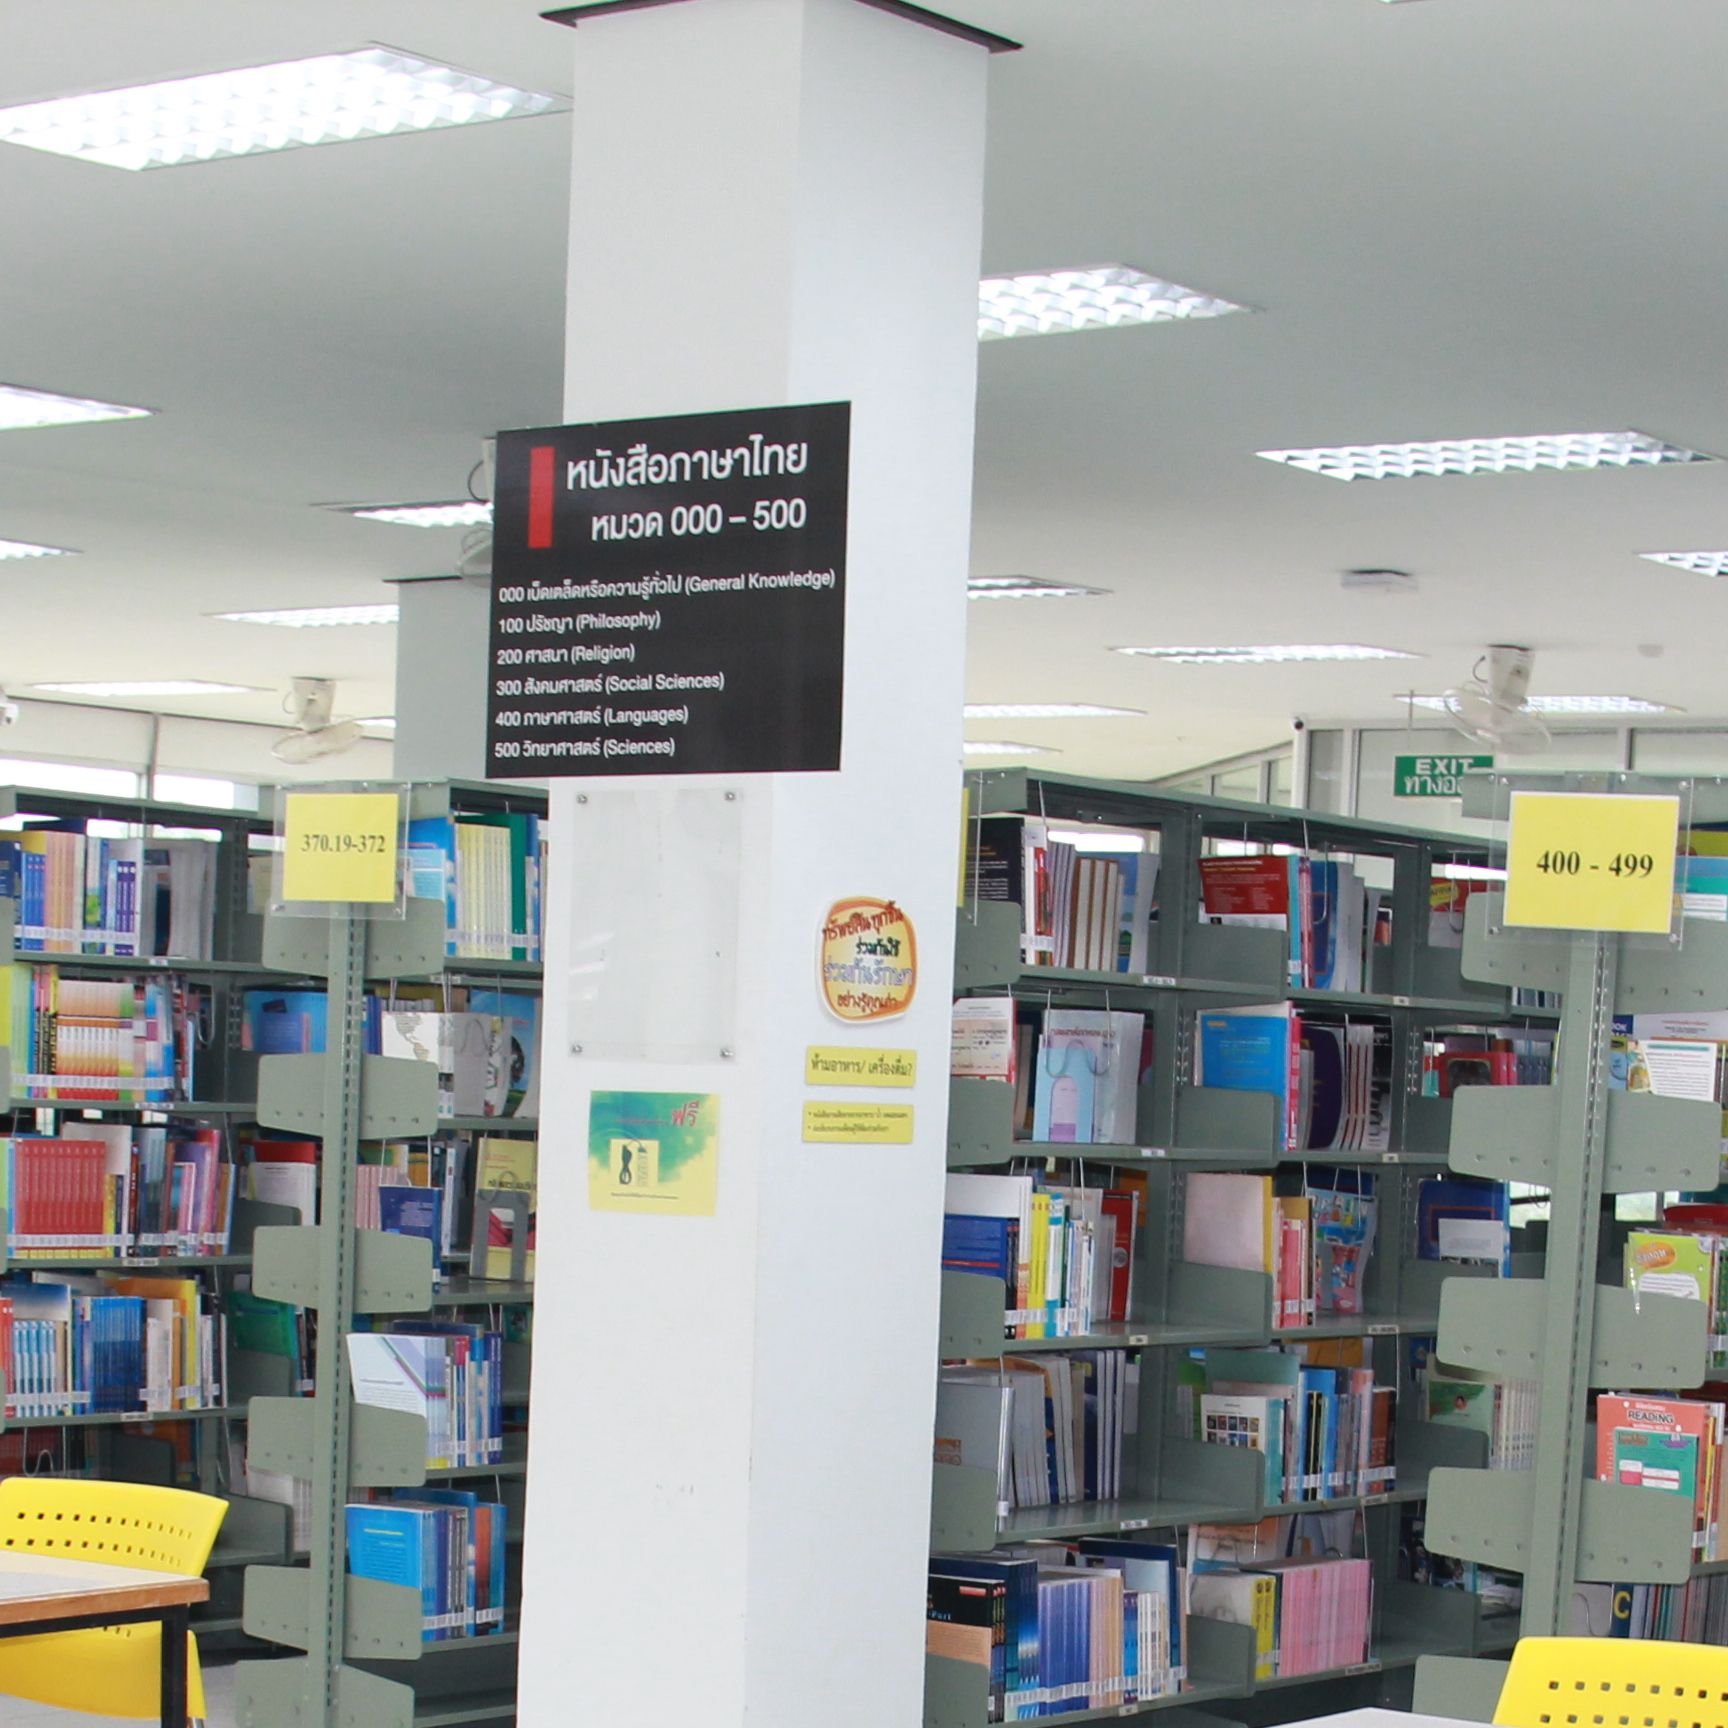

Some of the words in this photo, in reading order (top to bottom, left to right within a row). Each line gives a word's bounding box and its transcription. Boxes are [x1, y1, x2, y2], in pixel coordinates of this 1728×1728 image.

[567, 433, 808, 491] หนังสือภาษาไทย
[591, 510, 663, 541] หมวด
[671, 503, 723, 537] 000
[752, 498, 807, 531] 500
[499, 586, 524, 602] 000
[685, 574, 745, 595] (General
[749, 569, 835, 589] Knowledge)
[499, 618, 524, 633] 100
[576, 610, 661, 633] (Philosophy)
[497, 649, 522, 665] 200
[571, 643, 635, 665] (Religion)
[496, 680, 522, 696] 300
[605, 674, 653, 695] (Social
[655, 671, 725, 690] Sciences)
[495, 711, 521, 726] 400
[603, 705, 689, 727] (Languages)
[494, 742, 520, 758] 500
[603, 737, 676, 758] (Sciences)
[1415, 758, 1474, 774] EXIT
[301, 834, 386, 853] 370.19-372
[1536, 850, 1581, 876] 400
[1608, 853, 1654, 878] 499
[1627, 1409, 1675, 1424] READING
